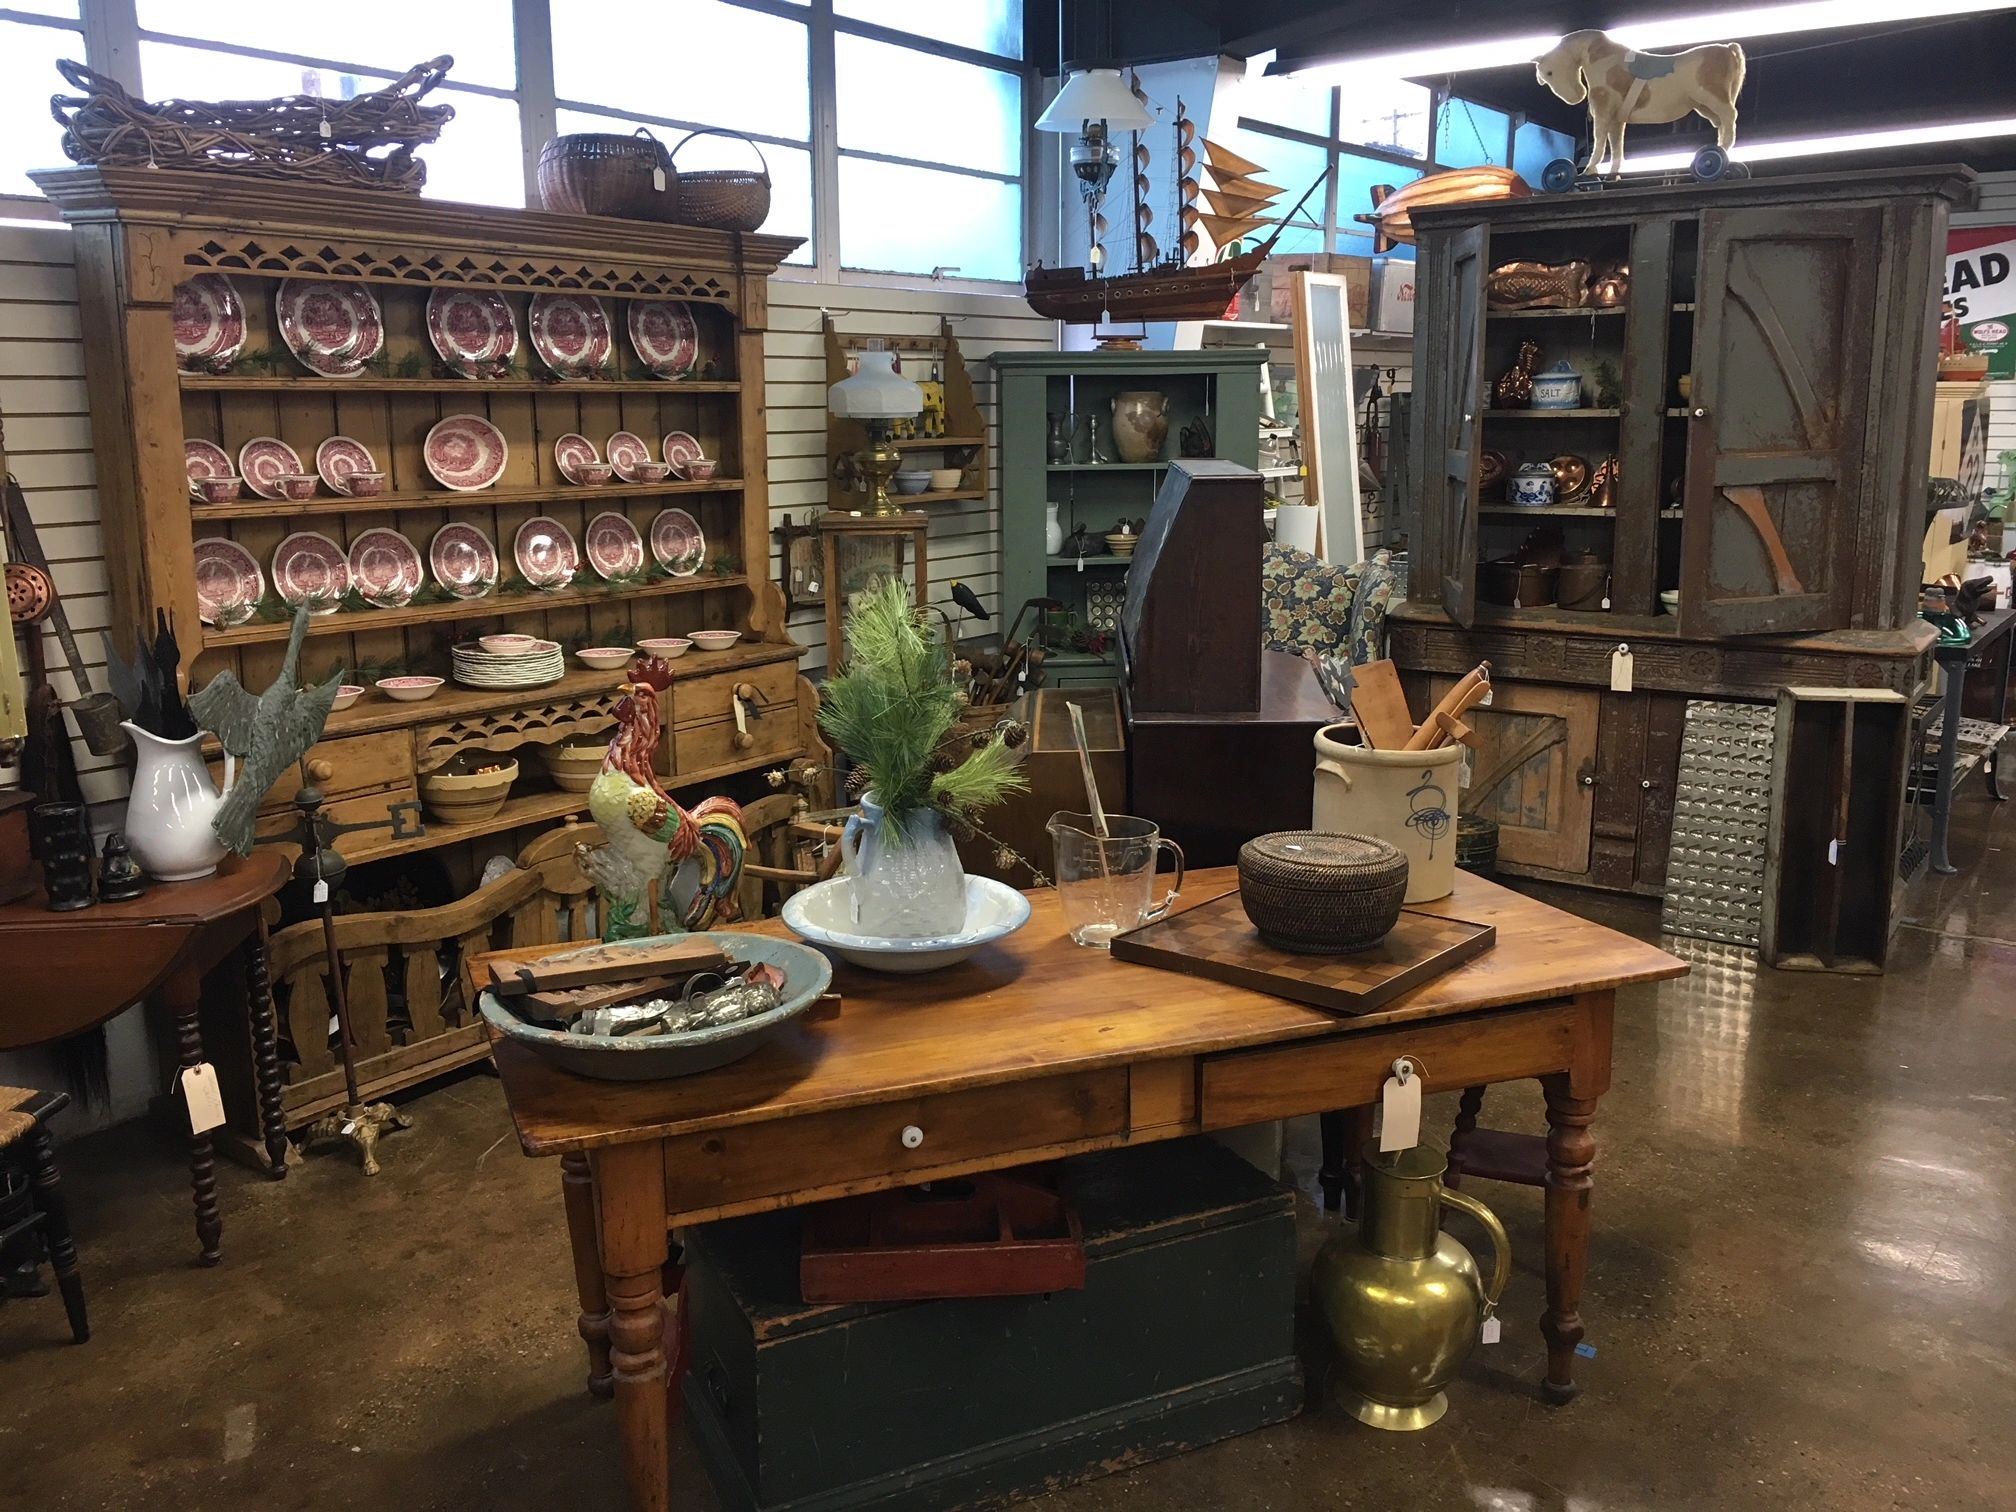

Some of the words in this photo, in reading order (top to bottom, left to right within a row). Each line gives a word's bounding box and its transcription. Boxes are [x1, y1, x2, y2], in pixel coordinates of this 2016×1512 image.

[1942, 252, 2010, 295] AD
[1540, 388, 1561, 398] SALT
[387, 800, 425, 840] E
